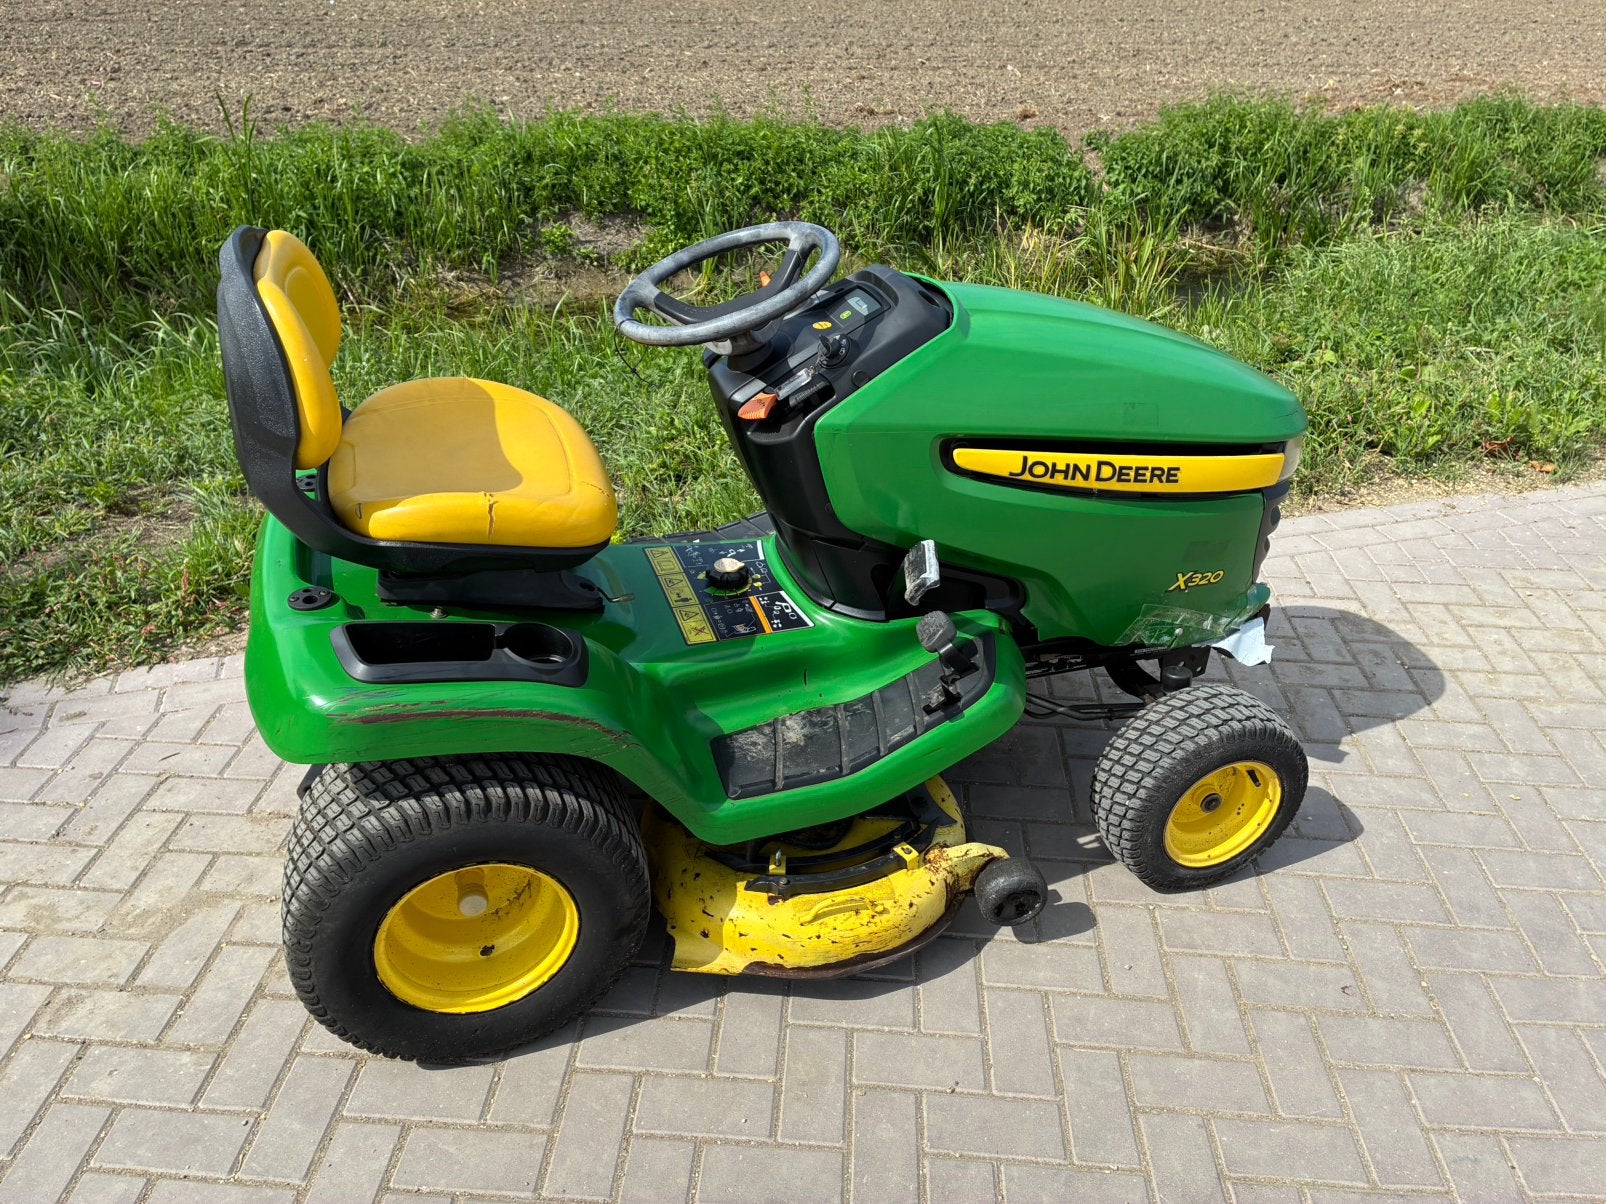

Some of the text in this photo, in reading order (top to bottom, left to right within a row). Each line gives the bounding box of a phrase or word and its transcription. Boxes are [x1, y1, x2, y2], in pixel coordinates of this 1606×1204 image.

[1009, 455, 1181, 484] JOHN DEERE
[1166, 570, 1224, 592] X320
